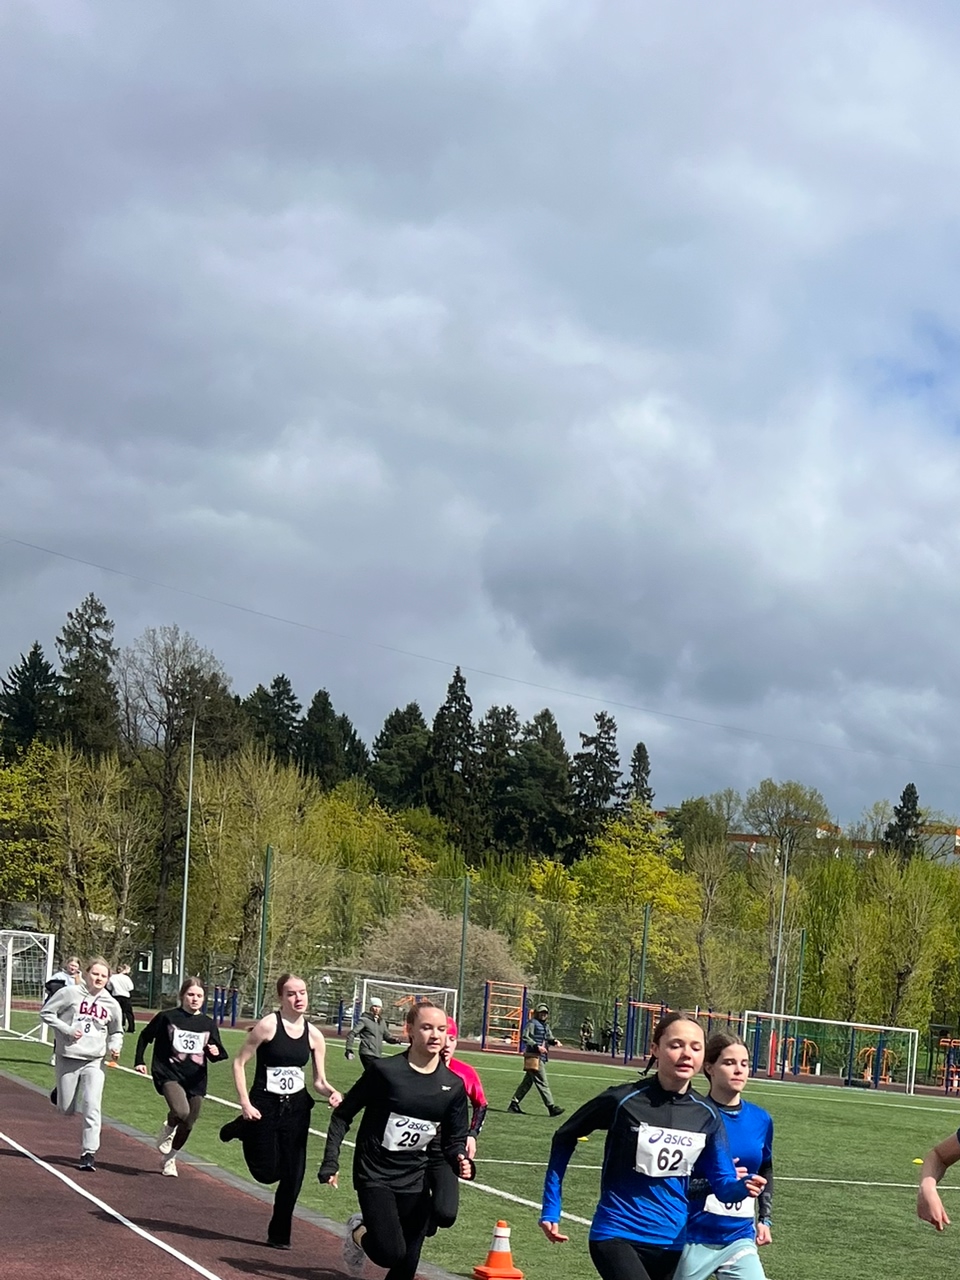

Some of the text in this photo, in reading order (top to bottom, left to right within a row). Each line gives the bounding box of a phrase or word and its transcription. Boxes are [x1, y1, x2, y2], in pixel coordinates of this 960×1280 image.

[80, 1001, 107, 1019] GAP
[84, 1023, 91, 1034] 8
[182, 1039, 195, 1050] 33
[280, 1077, 294, 1090] 30
[408, 1121, 430, 1132] asics
[397, 1131, 420, 1147] 29
[663, 1133, 693, 1147] asics
[657, 1147, 683, 1171] 62
